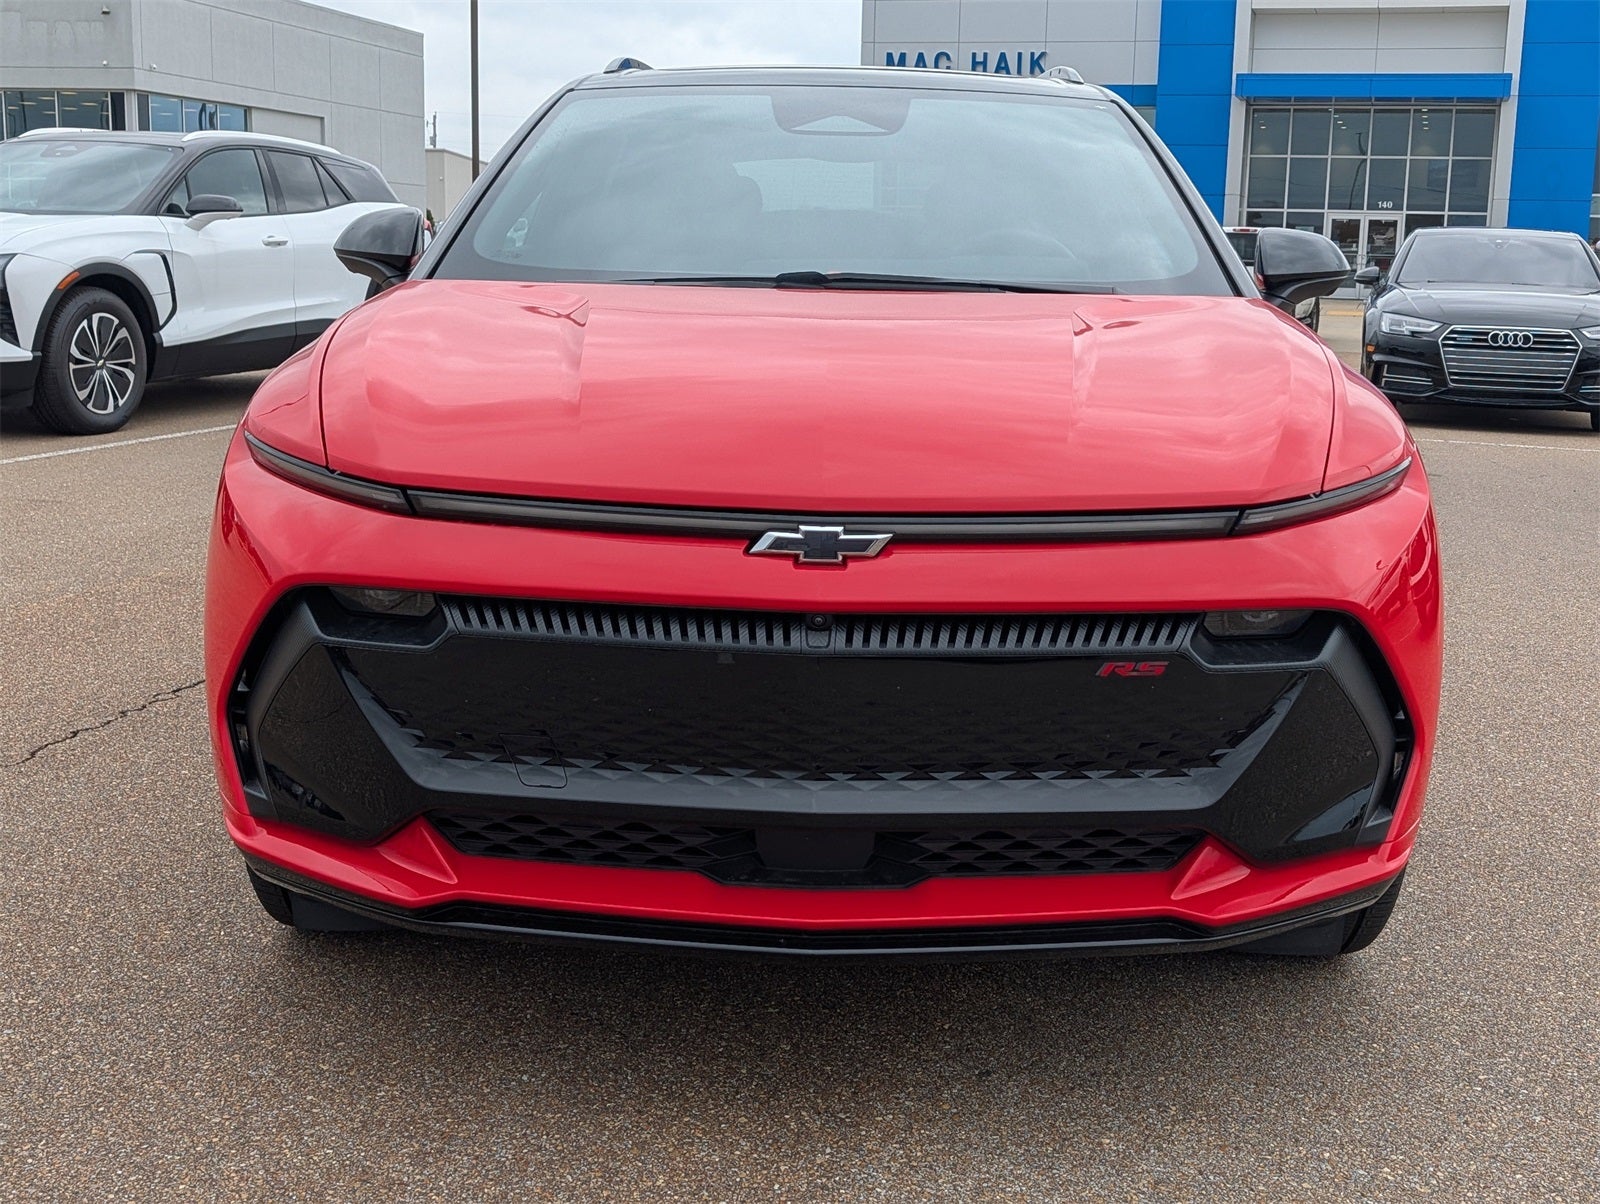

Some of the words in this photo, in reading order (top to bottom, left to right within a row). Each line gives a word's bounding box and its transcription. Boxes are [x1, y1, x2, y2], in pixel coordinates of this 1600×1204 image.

[970, 51, 1048, 75] HAIK
[1377, 200, 1393, 209] 140
[1095, 661, 1169, 677] RS
